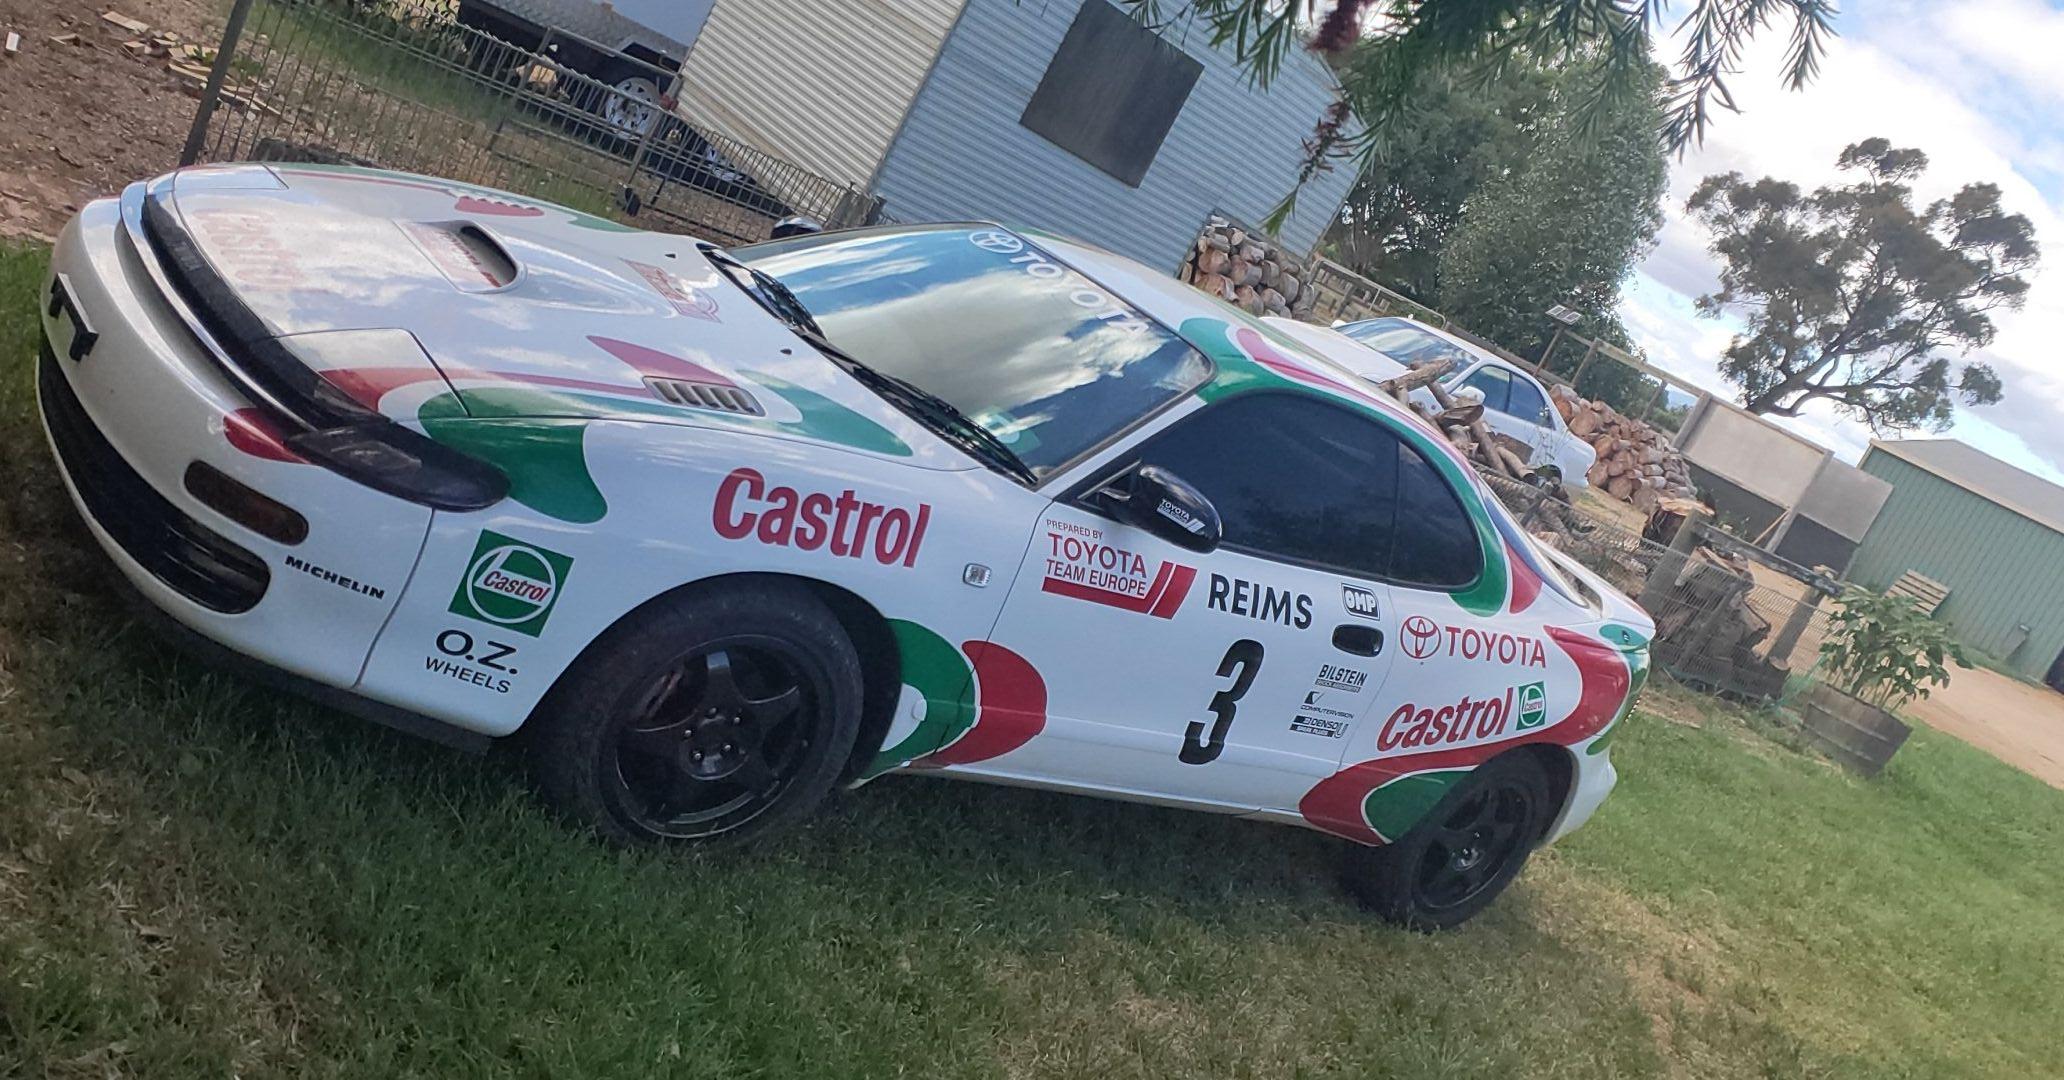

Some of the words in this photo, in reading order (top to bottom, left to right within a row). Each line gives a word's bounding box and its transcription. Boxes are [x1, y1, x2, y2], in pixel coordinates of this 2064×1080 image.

[1009, 251, 1149, 335] TOYOTA
[713, 467, 931, 568] Castrol
[1046, 519, 1090, 537] PREPARED
[1092, 530, 1103, 539] BY
[1161, 499, 1190, 520] TOYOTA
[1048, 532, 1147, 578] TOYOTA
[285, 555, 385, 600] MICHELIN
[483, 570, 551, 603] Castrol
[1046, 559, 1085, 582] TEAM
[1089, 570, 1147, 596] EUROPE
[1208, 573, 1313, 630] REIMS
[1344, 590, 1376, 613] OMP
[436, 629, 518, 675] O.Z.
[1445, 626, 1546, 668] TOYOTA
[426, 656, 512, 694] WHEELS
[1318, 664, 1367, 686] BILSTEIN
[1178, 638, 1265, 765] 3
[1300, 704, 1354, 719] COMPUTERVISION
[1377, 687, 1513, 752] Castrol
[1311, 717, 1339, 730] DENSO
